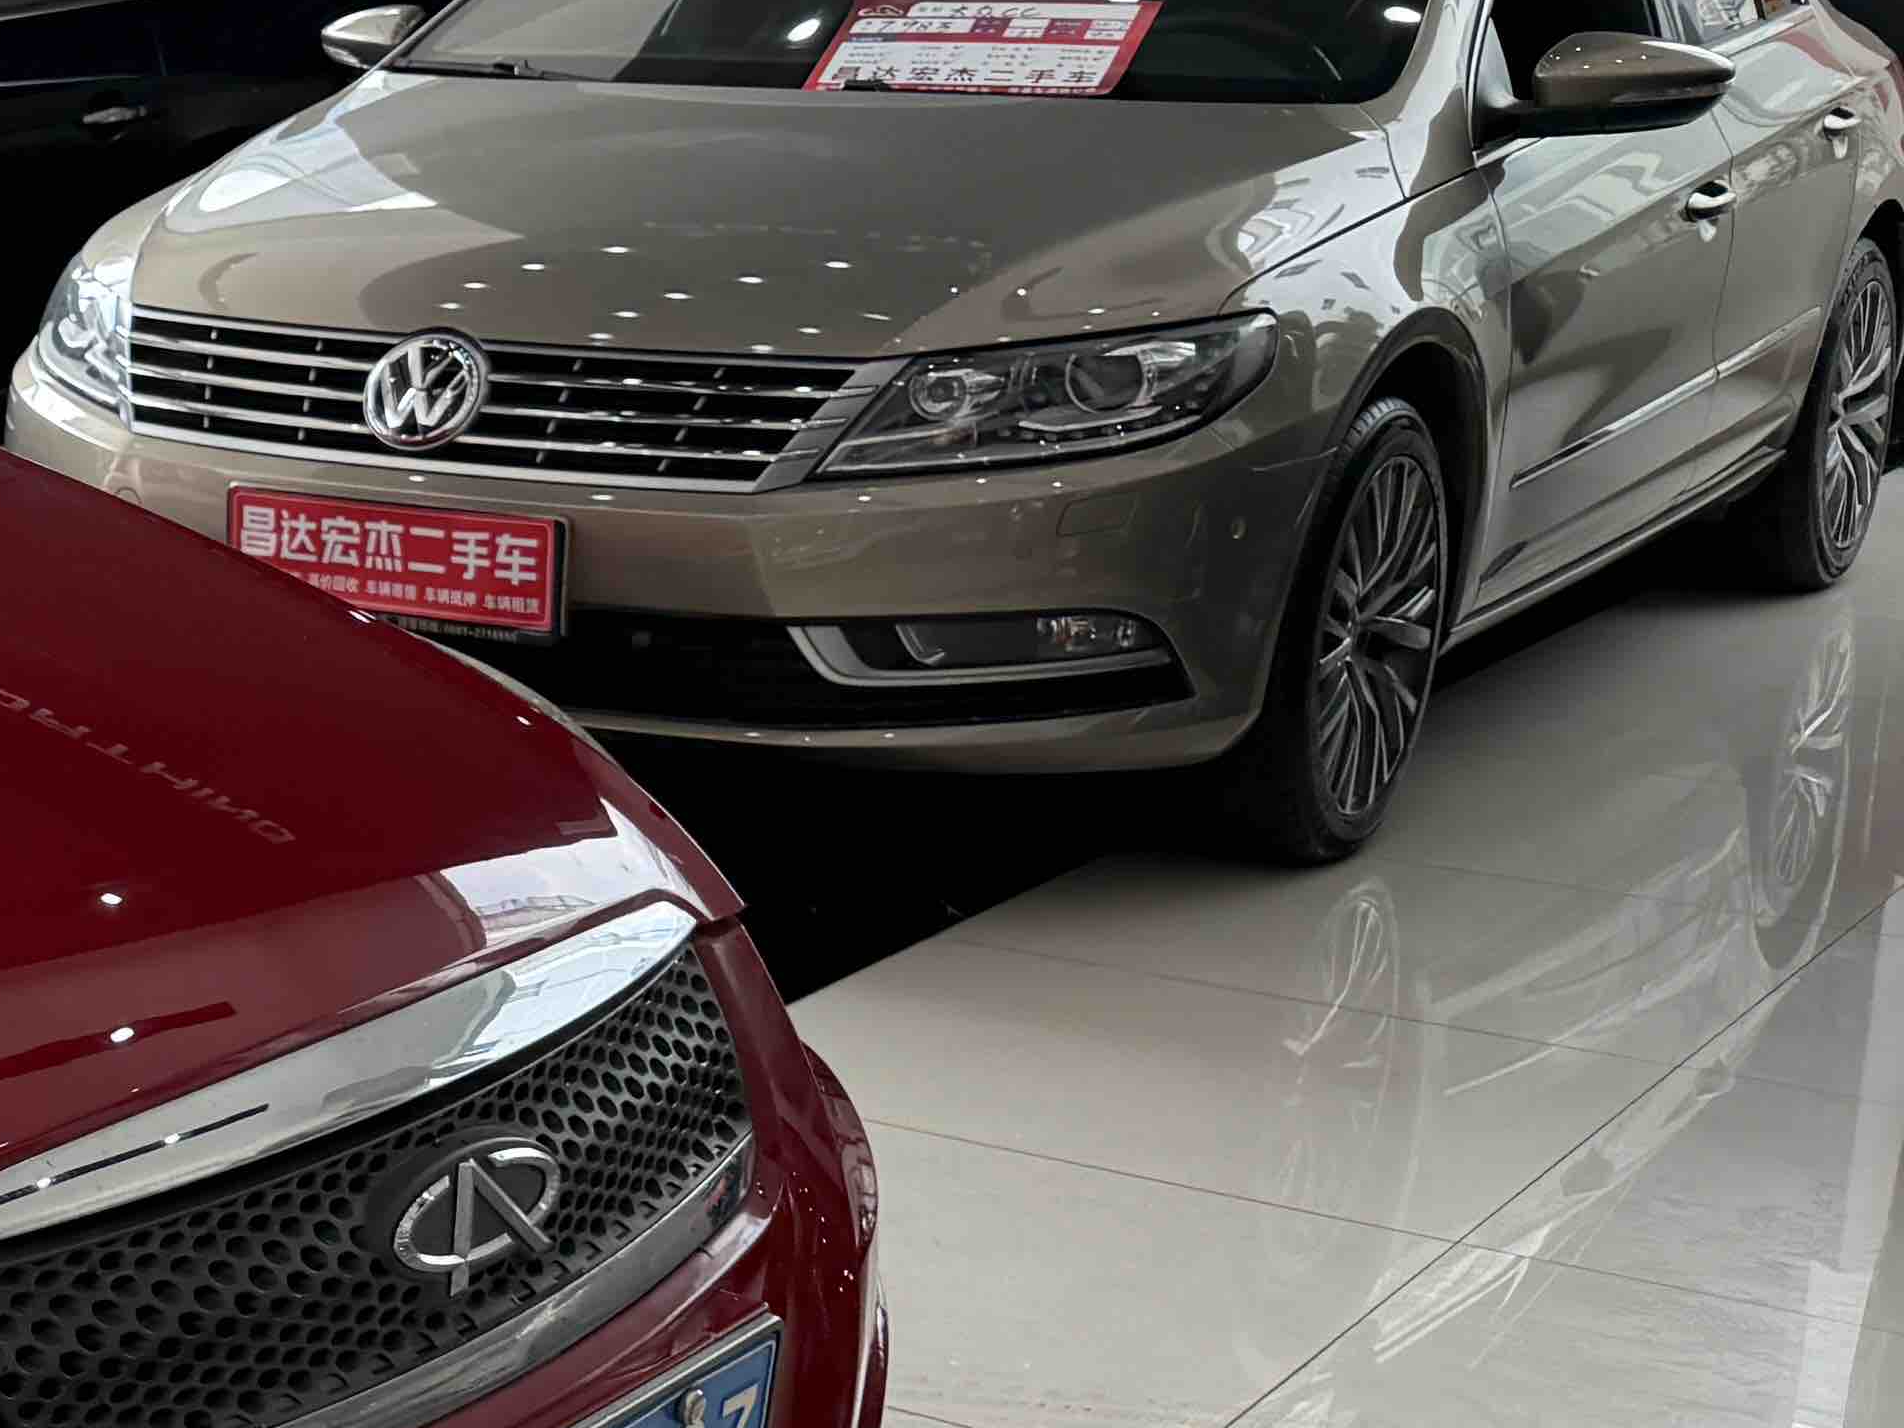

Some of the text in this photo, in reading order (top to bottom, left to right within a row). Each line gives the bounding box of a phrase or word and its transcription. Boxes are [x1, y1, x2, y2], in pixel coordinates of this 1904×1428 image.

[240, 504, 540, 586] 昌达宏杰二手车
